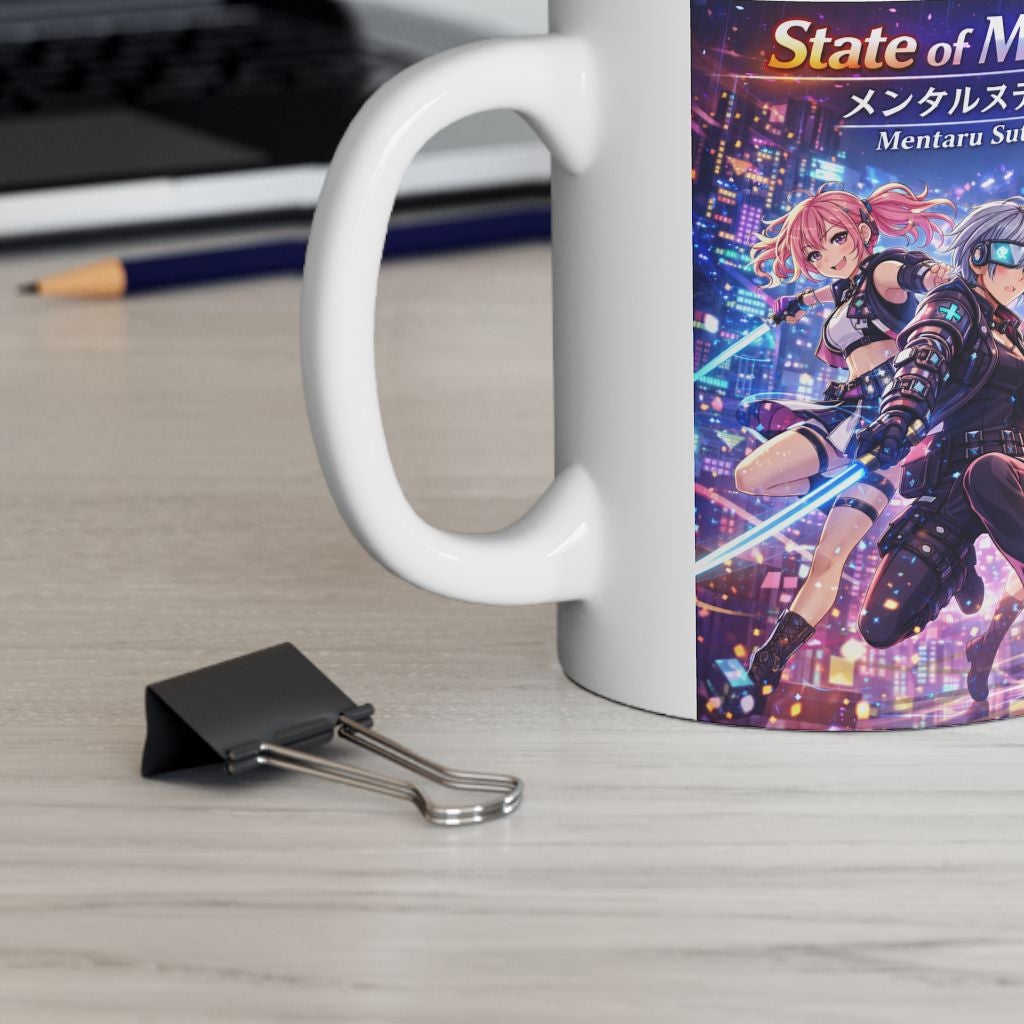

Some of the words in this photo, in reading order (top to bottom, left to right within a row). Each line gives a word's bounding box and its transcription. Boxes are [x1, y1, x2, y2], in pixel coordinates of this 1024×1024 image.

[767, 18, 918, 72] State
[926, 27, 973, 66] of
[875, 129, 983, 151] Mentaru
